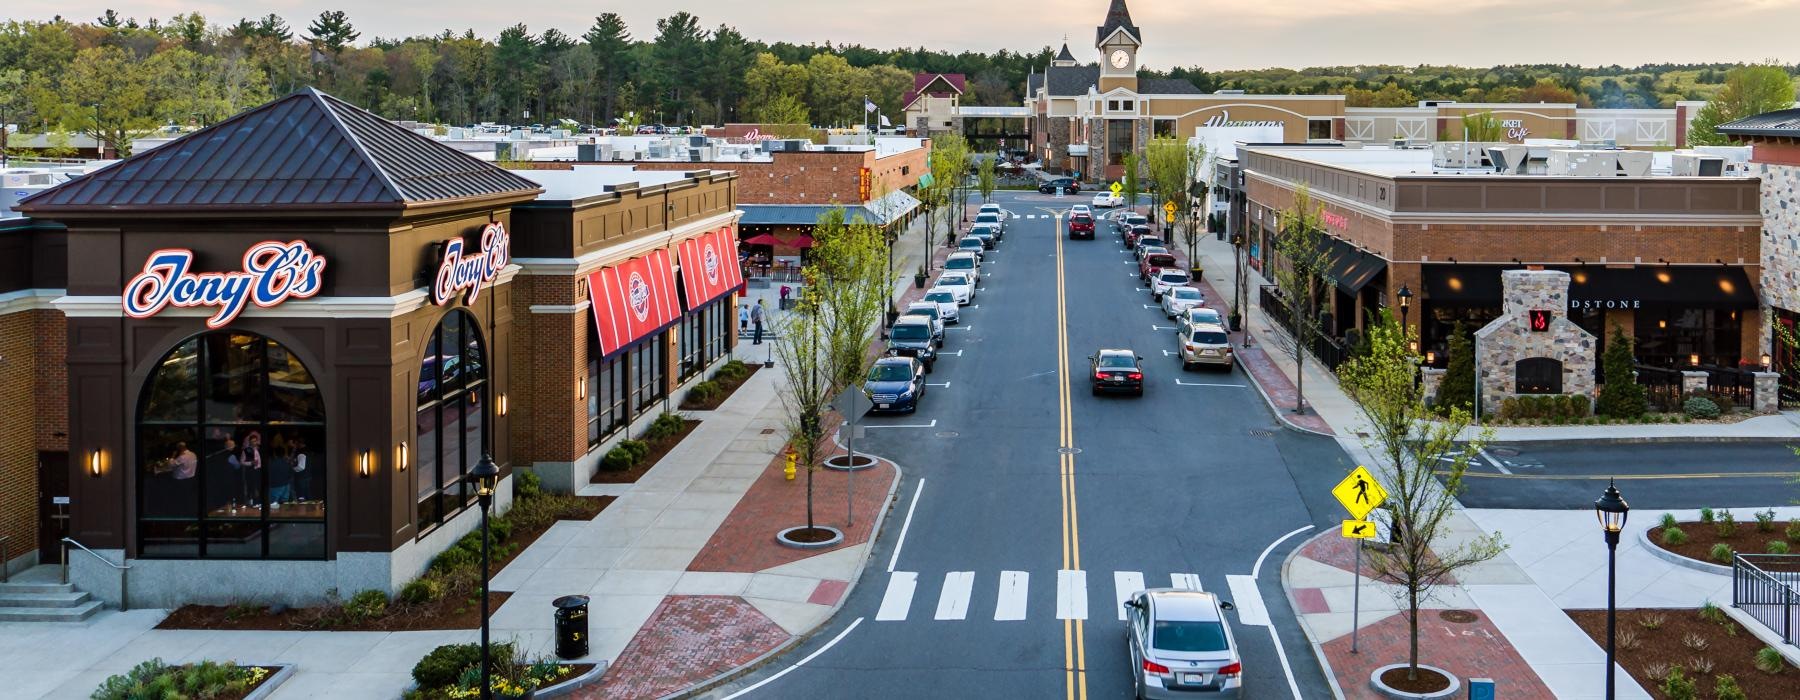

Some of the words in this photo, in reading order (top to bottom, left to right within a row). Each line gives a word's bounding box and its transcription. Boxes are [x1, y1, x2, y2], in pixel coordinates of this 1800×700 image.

[124, 248, 253, 327] Tony
[244, 240, 326, 306] C's
[435, 238, 485, 305] Tony
[482, 222, 509, 281] C's
[578, 277, 586, 297] 17
[1571, 300, 1640, 308] DSTONE
